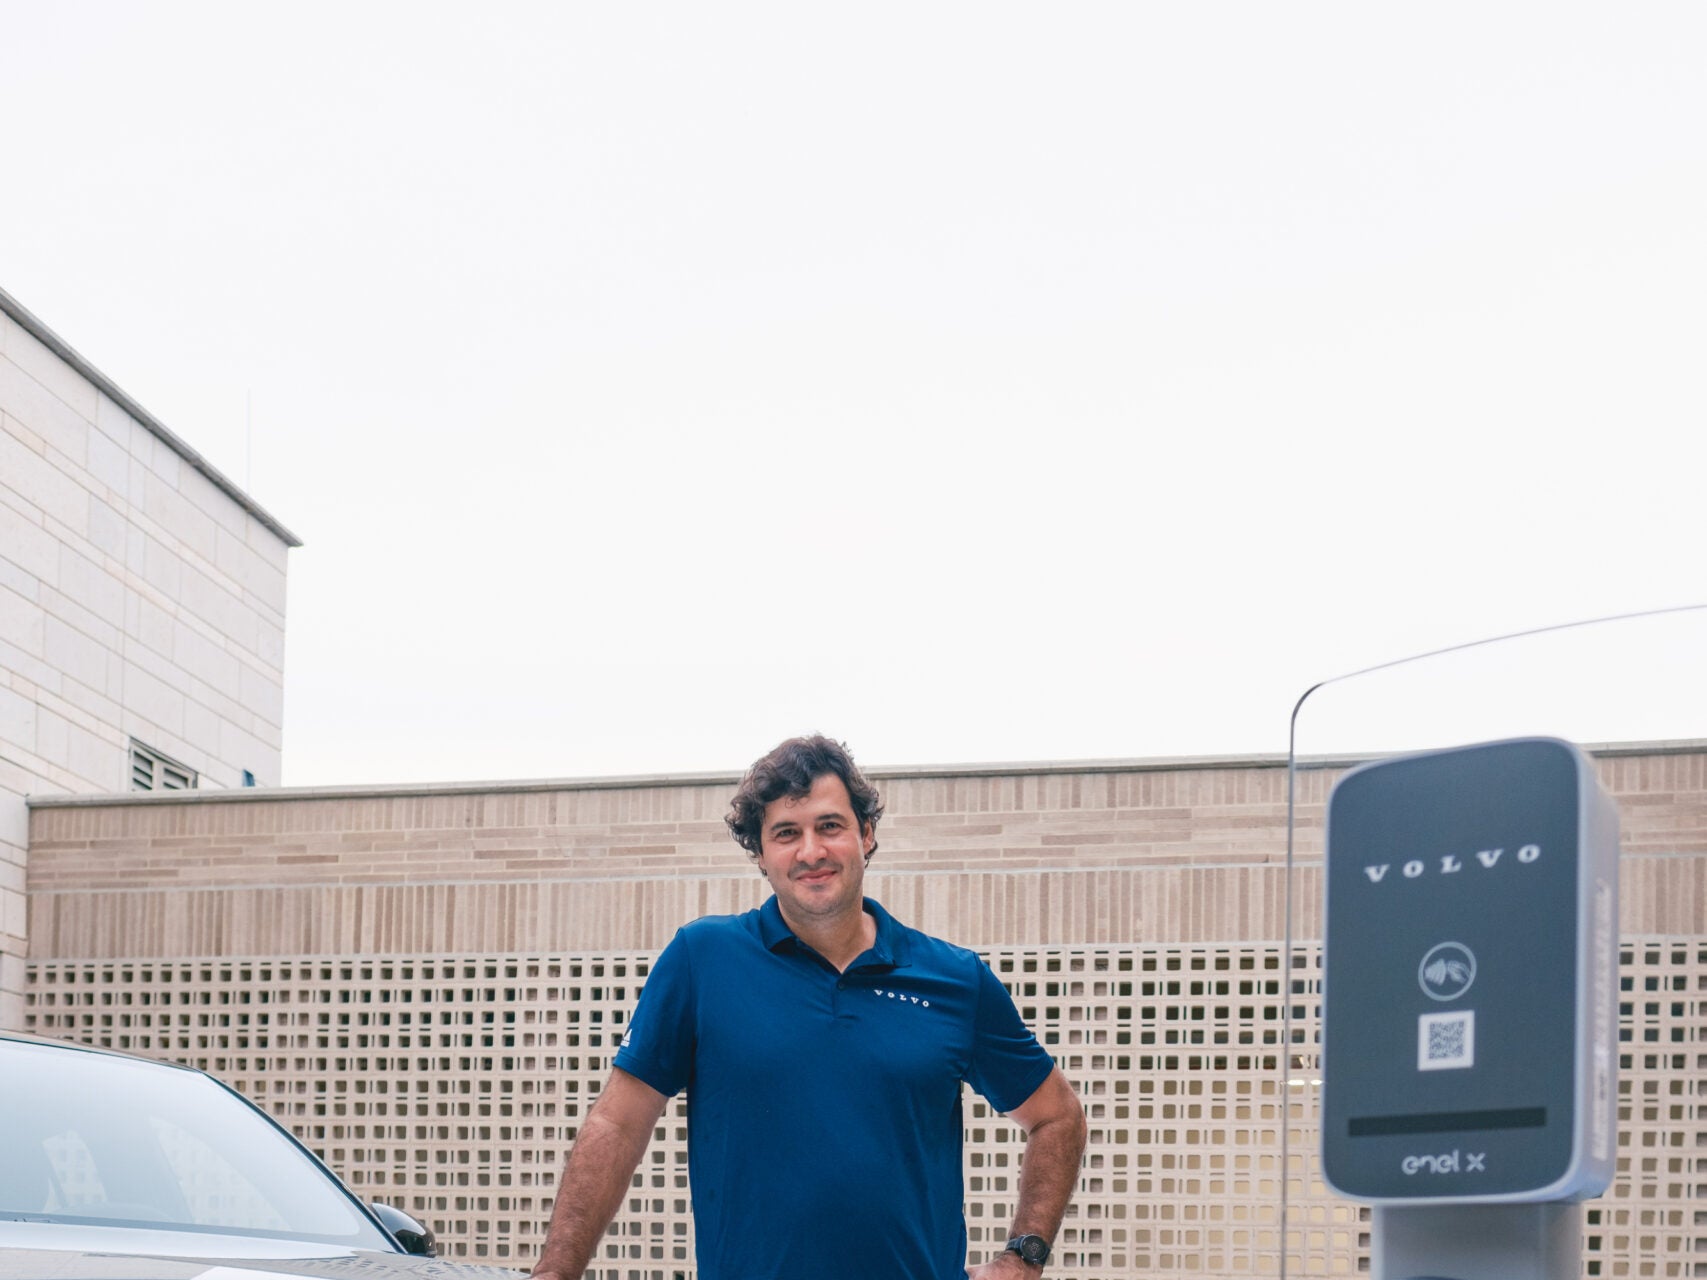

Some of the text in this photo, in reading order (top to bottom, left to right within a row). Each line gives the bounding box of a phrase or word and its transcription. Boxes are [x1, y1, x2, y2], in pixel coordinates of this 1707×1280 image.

[1364, 844, 1541, 882] VOLVO
[874, 989, 929, 1007] VOLVO
[1401, 1149, 1460, 1175] enel
